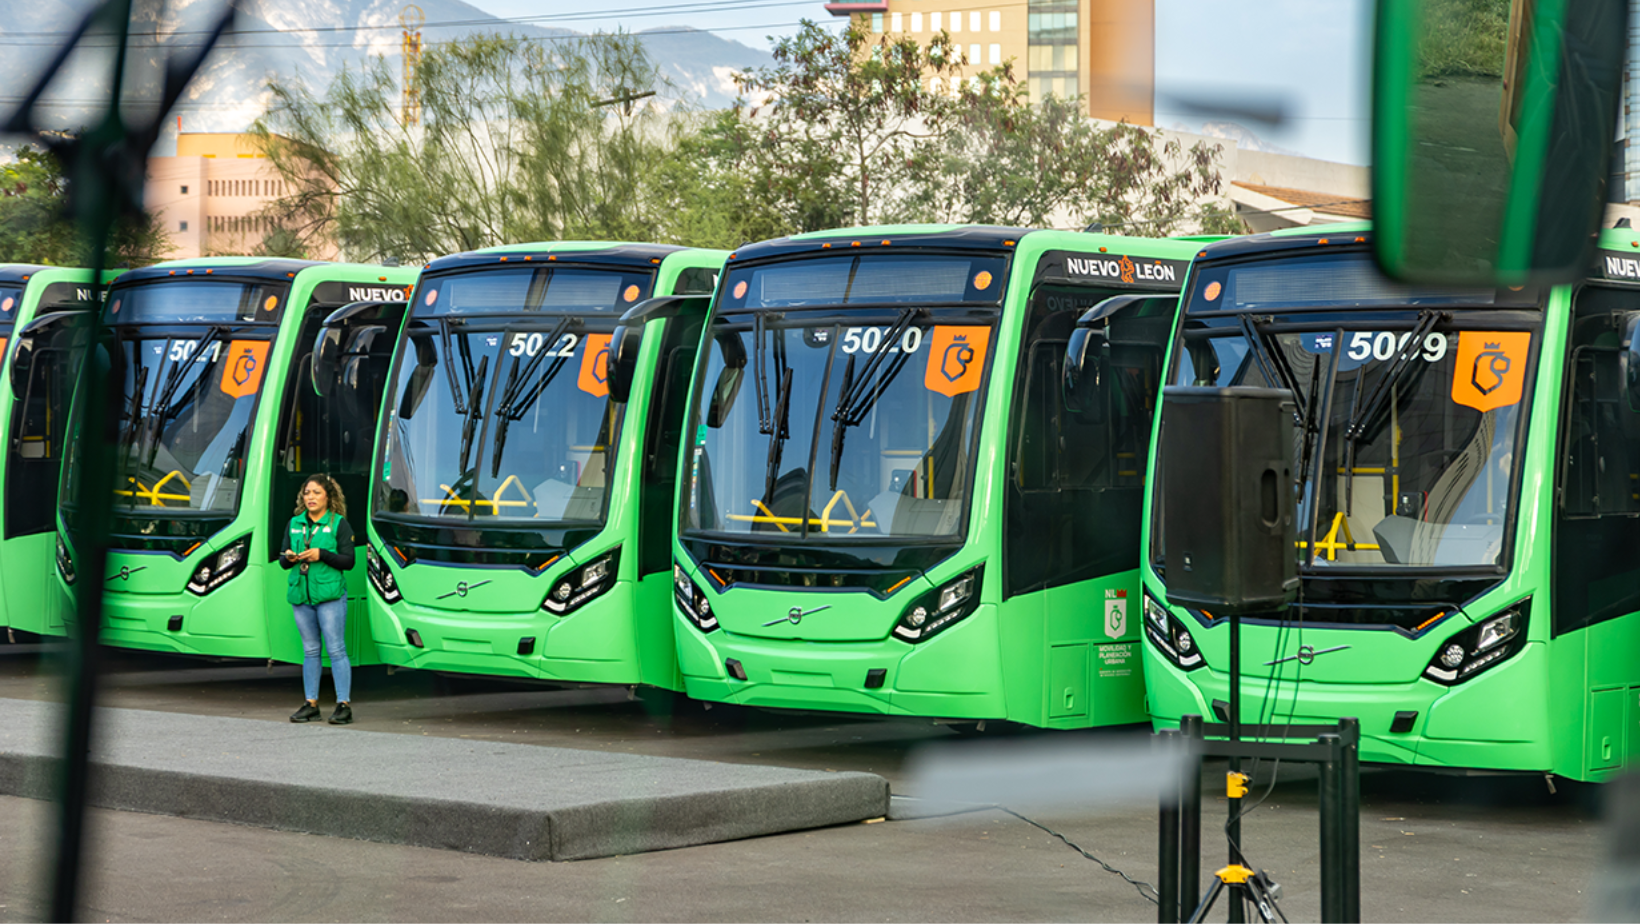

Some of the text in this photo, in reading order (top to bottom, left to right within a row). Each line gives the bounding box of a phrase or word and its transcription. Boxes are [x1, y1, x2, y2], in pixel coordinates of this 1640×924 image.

[1067, 258, 1175, 281] NUEVO LEÓN
[349, 287, 404, 301] NUEVO
[1104, 589, 1117, 599] NL
